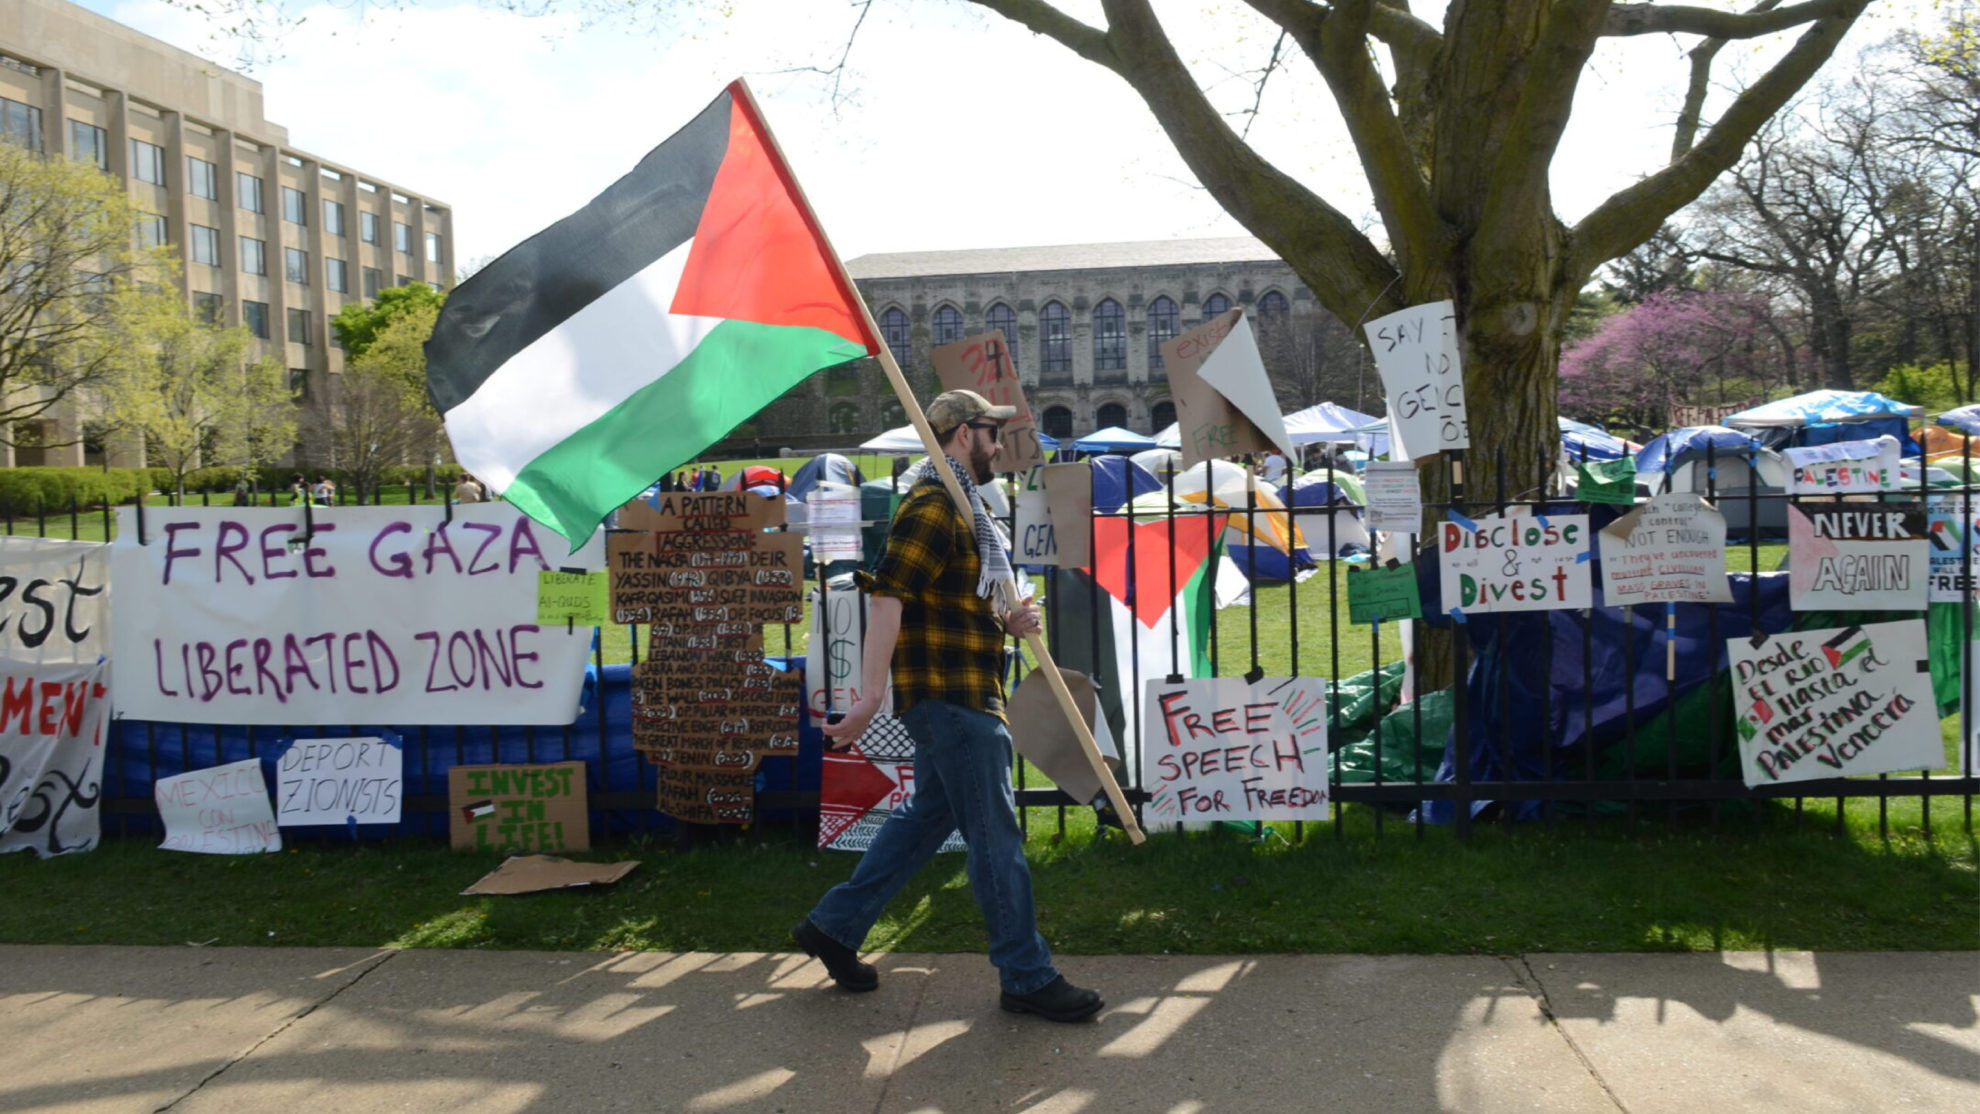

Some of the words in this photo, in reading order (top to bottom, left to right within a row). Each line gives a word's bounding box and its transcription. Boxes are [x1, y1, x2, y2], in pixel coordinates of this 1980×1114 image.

[1378, 317, 1423, 353] SAY
[1794, 467, 1891, 488] PALESTINE
[660, 497, 675, 516] A
[681, 495, 746, 515] PATTERN
[683, 517, 731, 530] CALLED
[1813, 512, 1911, 540] NEVER
[163, 521, 336, 585] FREE
[368, 515, 552, 578] GAZA
[1624, 531, 1657, 549] NOT
[1666, 528, 1710, 545] ENOUGH
[619, 551, 645, 569] THE
[751, 551, 788, 567] DEIR
[1502, 549, 1522, 577] &
[543, 573, 596, 585] LIBERATE
[615, 571, 667, 589] YASSIN
[708, 570, 750, 587] QIBYA
[1460, 566, 1568, 608] Divest
[1812, 555, 1910, 595] AGAIN
[1928, 575, 1978, 591] FREE
[652, 607, 693, 623] RAFAH
[154, 629, 399, 703] LIBERATED
[414, 625, 544, 692] ZONE
[1737, 640, 1810, 685] Desde
[1860, 647, 1890, 673] el
[1748, 679, 1777, 700] EL
[1157, 691, 1280, 747] FREE
[1766, 706, 1814, 746] mar
[282, 741, 389, 772] DEPORT
[674, 751, 710, 765] JENIN
[1157, 734, 1305, 781] SPEECH
[155, 765, 266, 811] MEXICO
[281, 778, 400, 815] ZIONISTS
[467, 768, 574, 798] INVEST
[1177, 787, 1231, 816] FOR
[1241, 777, 1329, 812] FREEDOM
[198, 808, 234, 829] CON
[500, 800, 544, 823] IN
[477, 821, 565, 850] LIFE!
